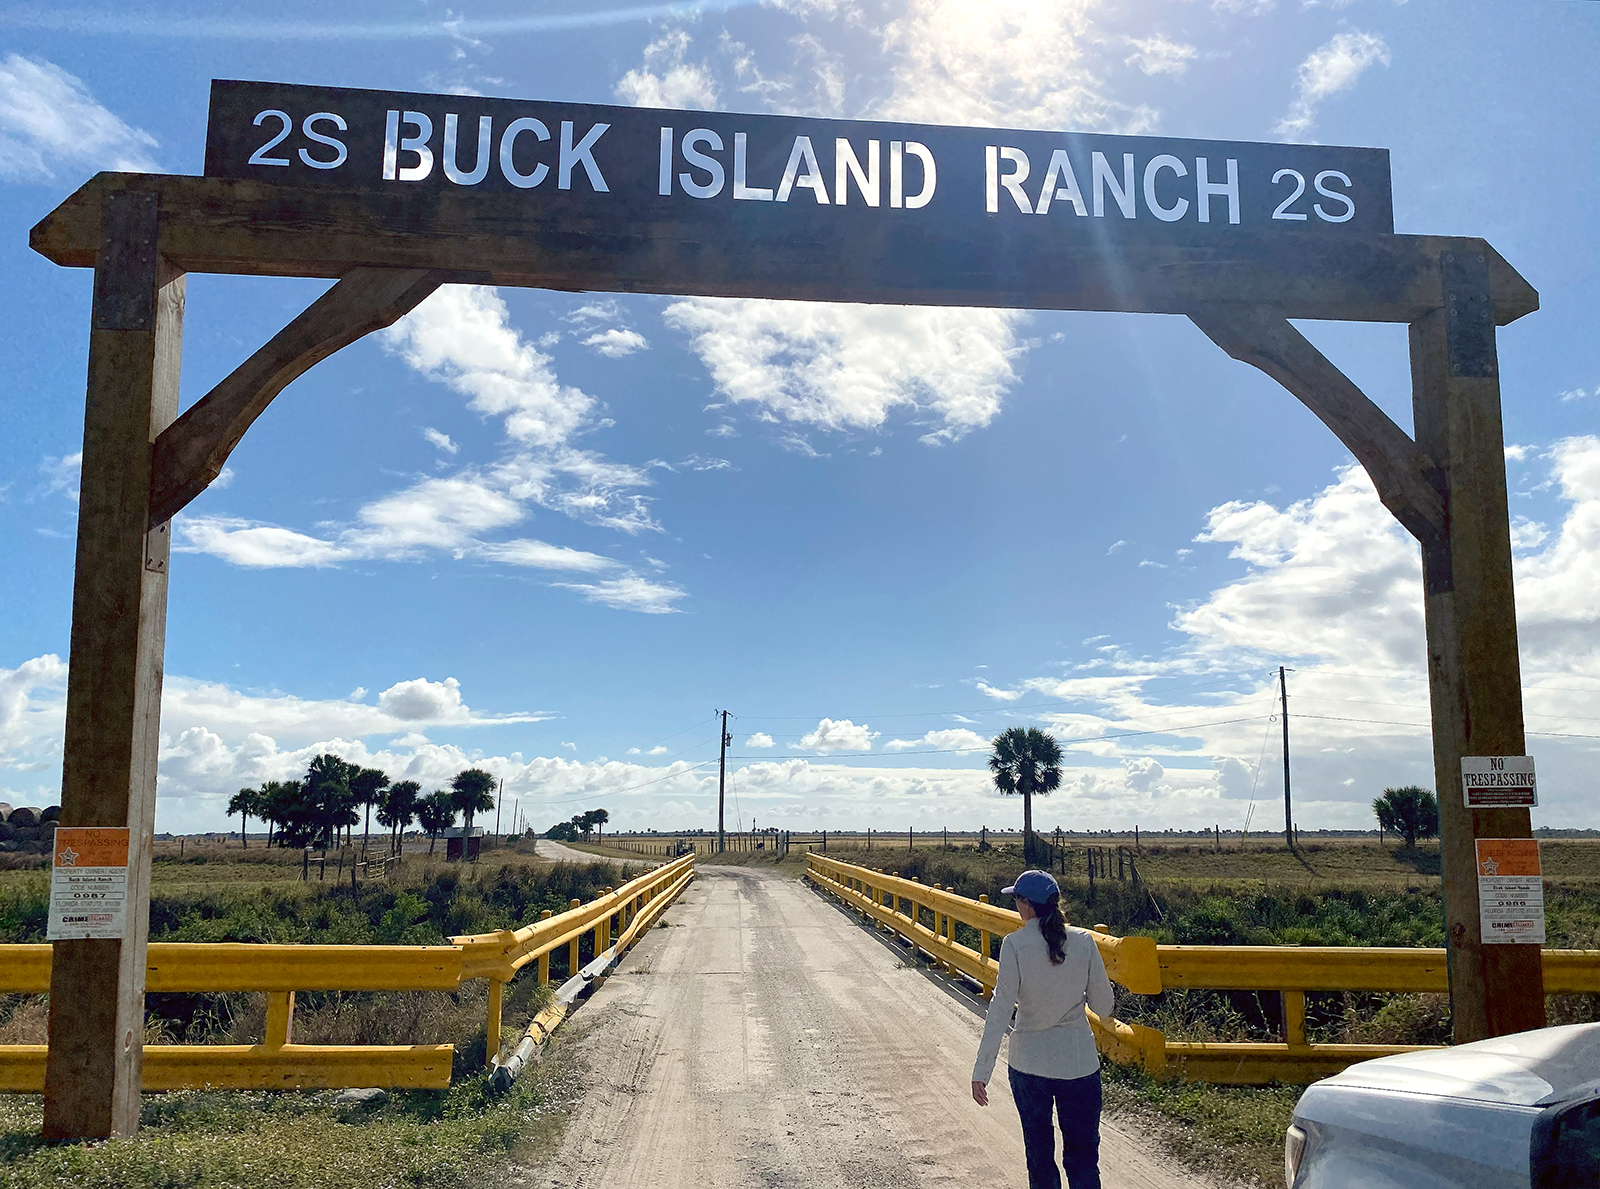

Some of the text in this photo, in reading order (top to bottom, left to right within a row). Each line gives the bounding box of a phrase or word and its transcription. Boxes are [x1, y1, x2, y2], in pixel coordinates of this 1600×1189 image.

[247, 109, 1356, 225] 2S BUCK ISLAND RANCH 2S
[1490, 757, 1504, 771] NO
[1463, 772, 1535, 787] TRESPASSING
[85, 829, 101, 838] NO
[58, 838, 129, 848] TRESPASSING
